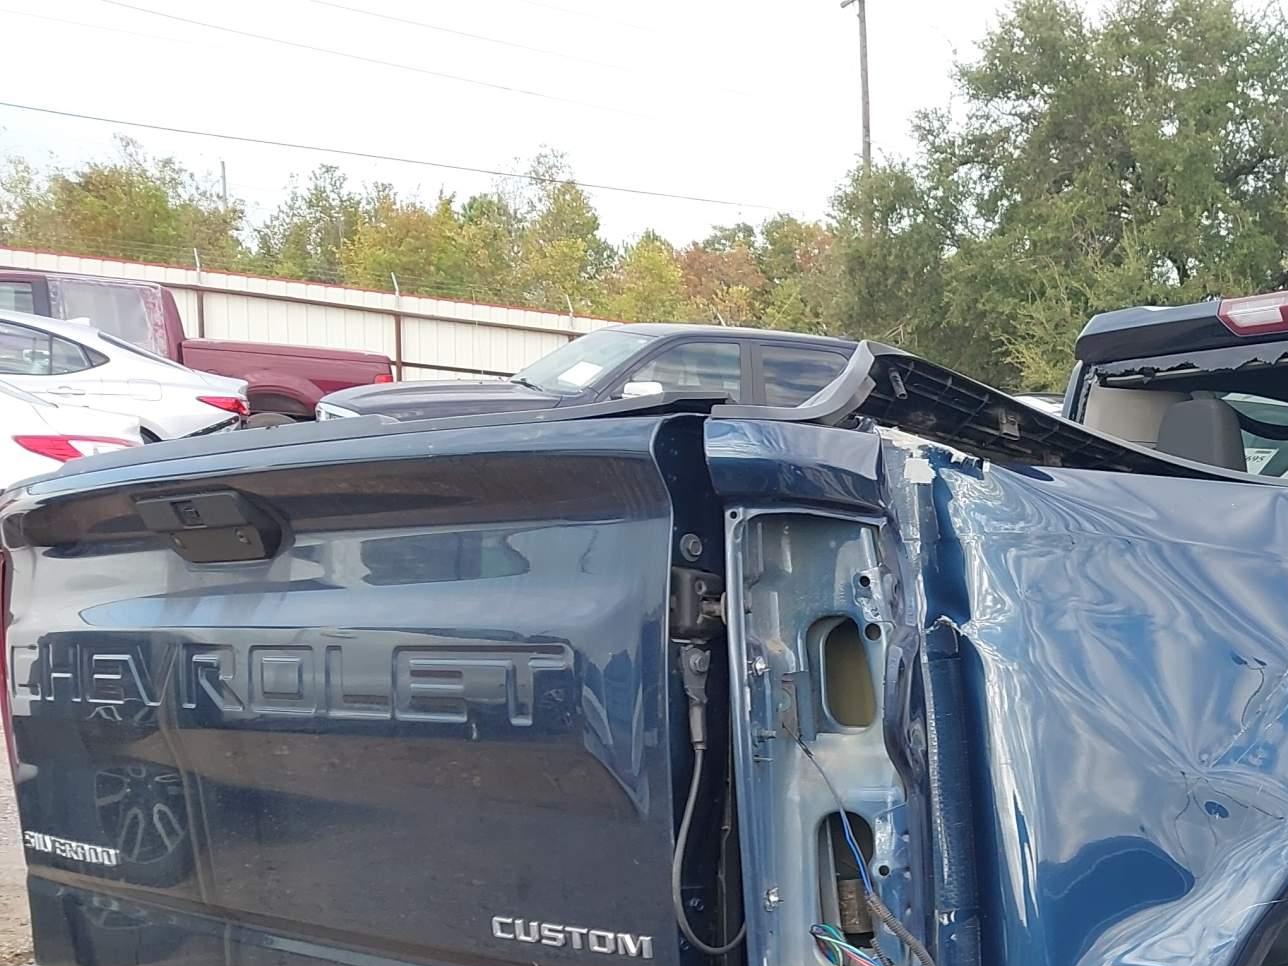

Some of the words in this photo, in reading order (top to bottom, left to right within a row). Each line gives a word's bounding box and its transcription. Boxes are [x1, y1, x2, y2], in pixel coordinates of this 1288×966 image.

[10, 641, 574, 727] CHEVROLET
[23, 830, 120, 866] SILVERADO
[492, 915, 654, 959] CUSTOM
